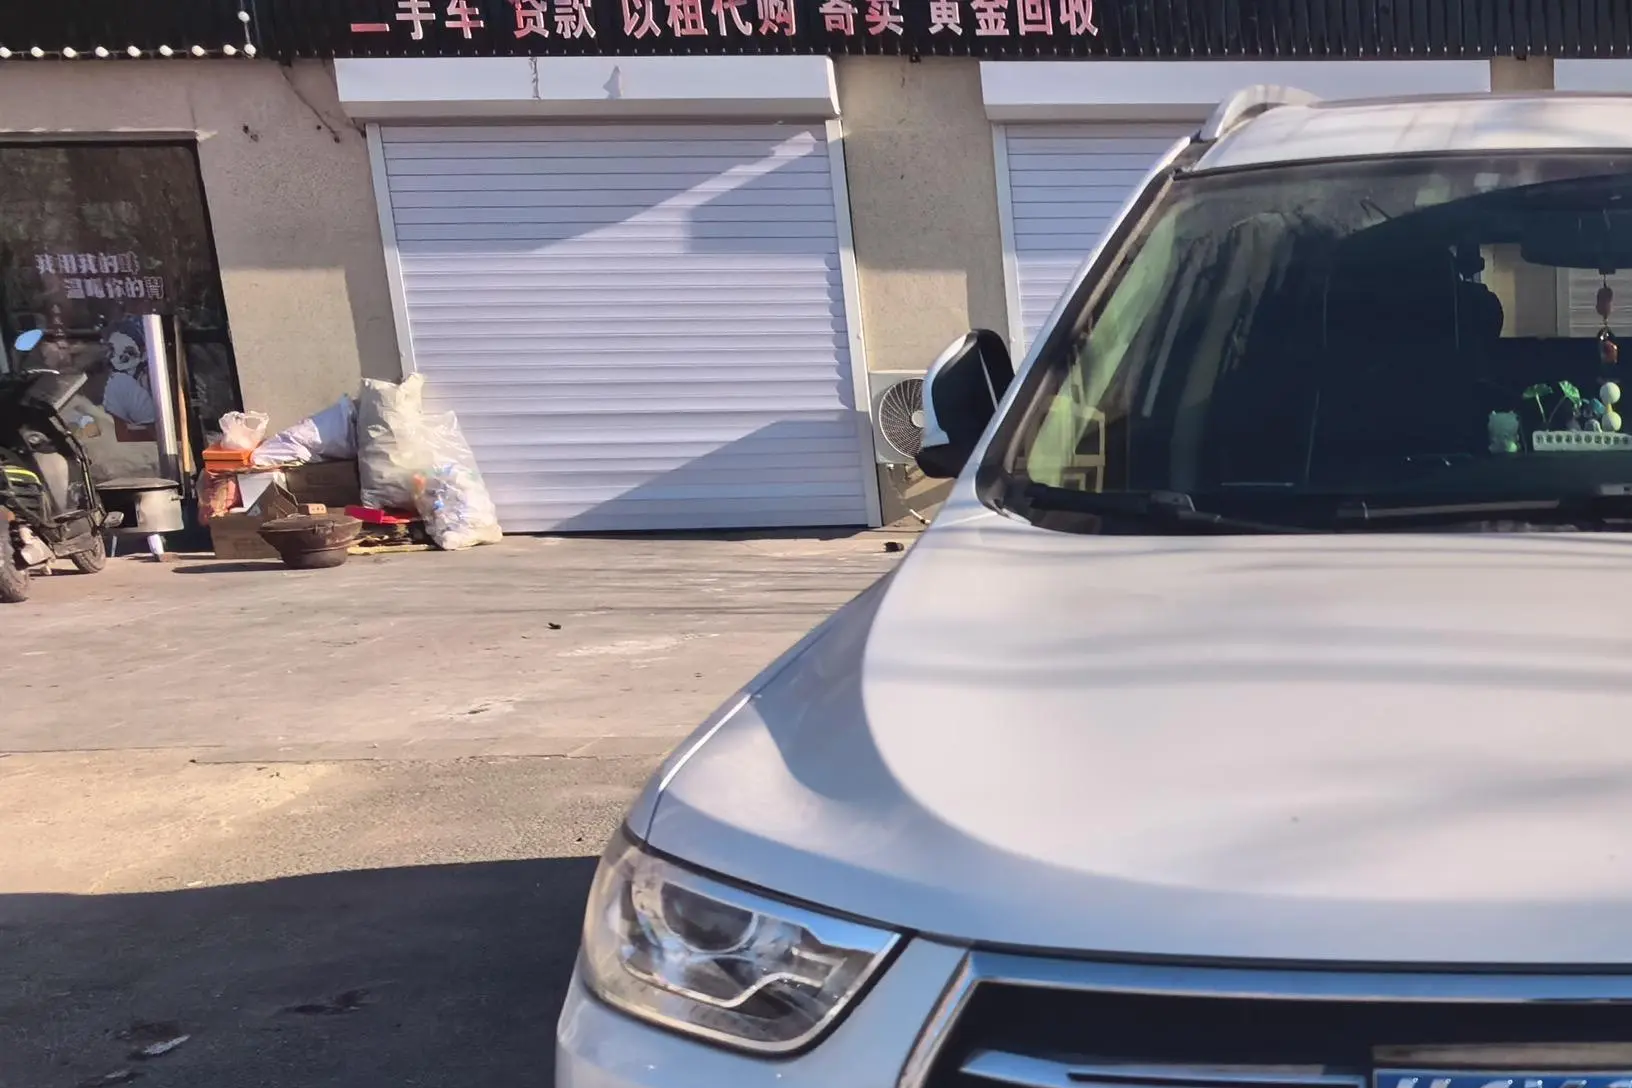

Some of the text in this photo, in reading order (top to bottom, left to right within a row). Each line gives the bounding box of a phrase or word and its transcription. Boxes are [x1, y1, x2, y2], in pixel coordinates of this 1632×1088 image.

[513, 0, 596, 39] 贷款
[620, 0, 797, 39] 以租代购
[928, 0, 1098, 36] 黄金回收
